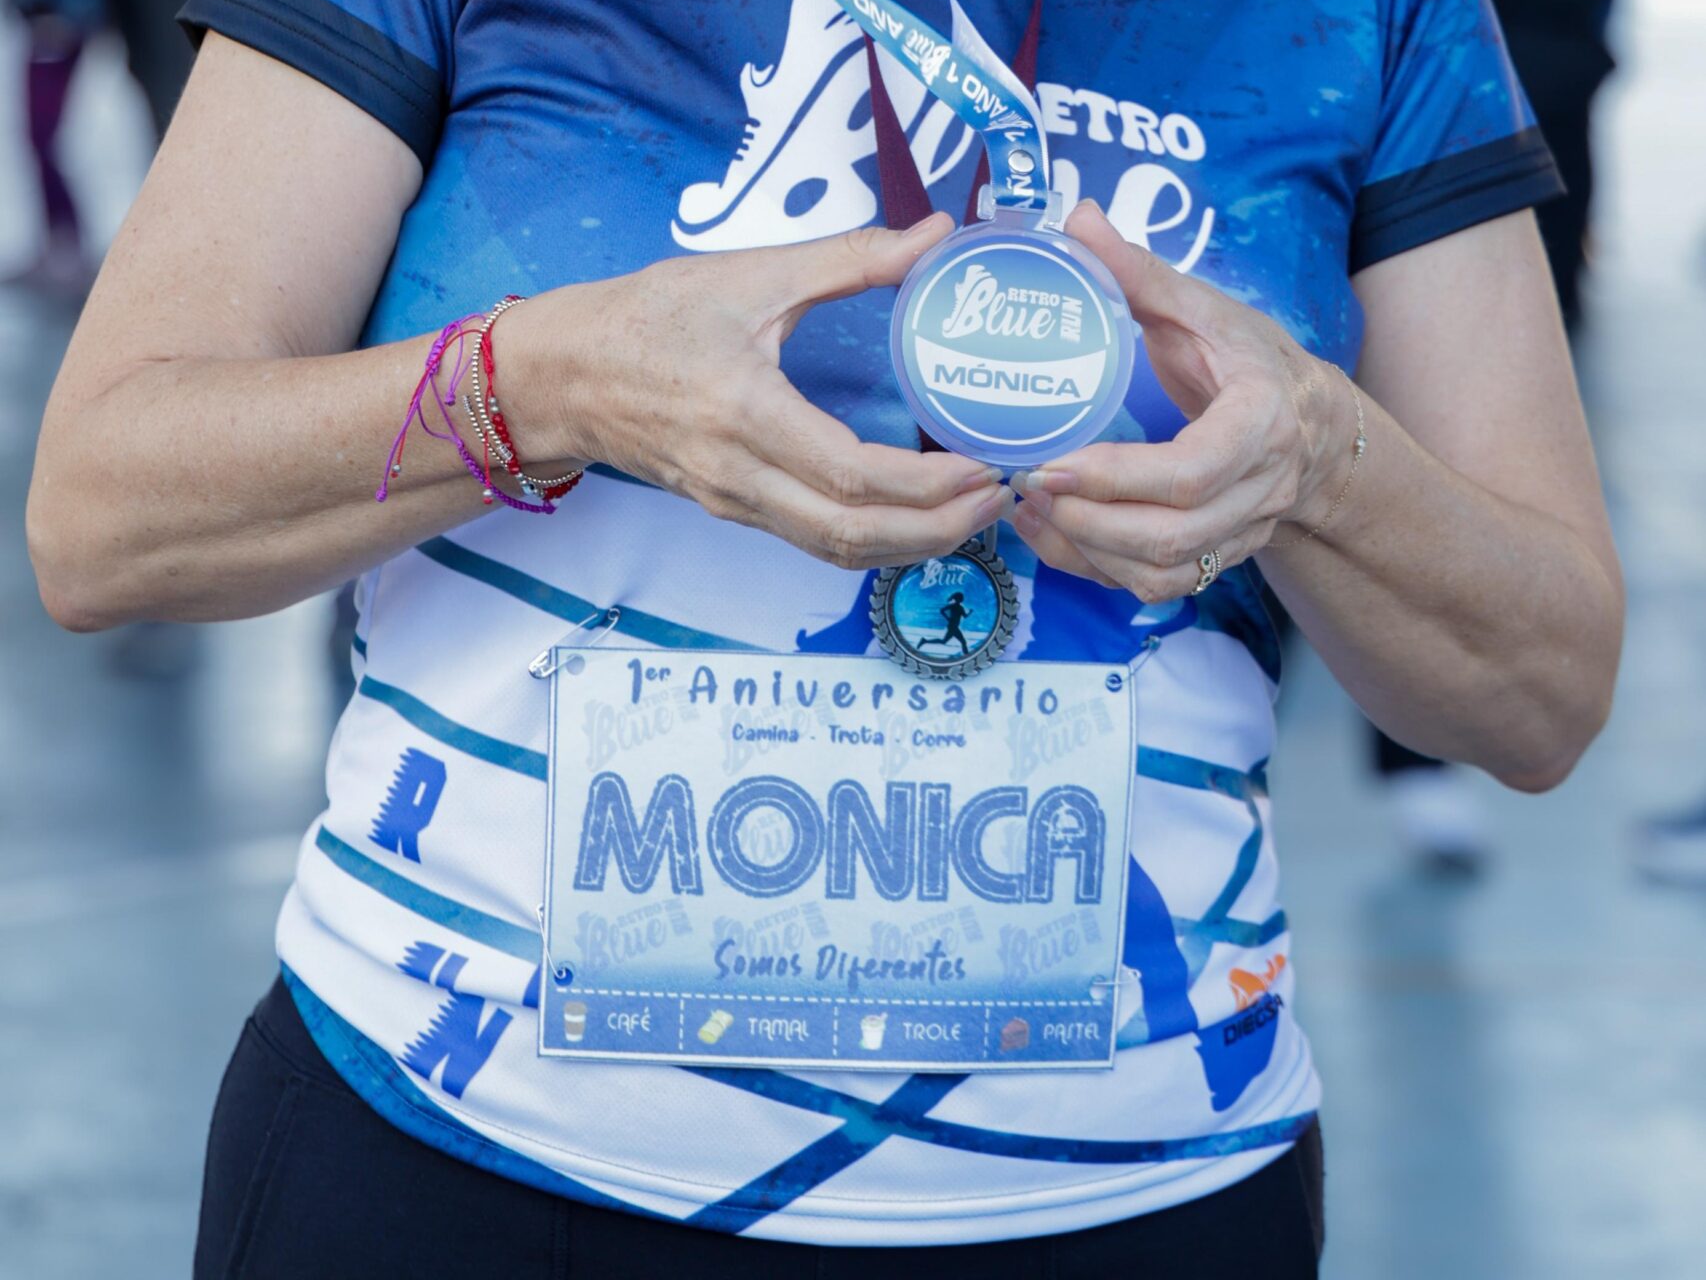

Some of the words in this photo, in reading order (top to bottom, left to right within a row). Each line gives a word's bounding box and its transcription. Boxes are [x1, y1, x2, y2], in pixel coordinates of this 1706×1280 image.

[945, 61, 959, 84] 1
[961, 73, 1009, 119] AÑO
[1035, 81, 1207, 162] ETRO
[942, 264, 1057, 339] Blue
[1007, 287, 1060, 308] RETRO
[934, 362, 1082, 399] MÓNICA
[627, 657, 672, 705] 1er
[687, 664, 1060, 716] Aniversario
[731, 722, 800, 744] Camina
[828, 724, 885, 746] Trota
[911, 728, 967, 749] Corre
[572, 770, 1107, 904] MONICA
[713, 938, 803, 981] Somos
[815, 939, 967, 992] Diferentes
[606, 1006, 651, 1036] CAFÉ
[747, 1016, 811, 1042] TAMAL
[903, 1021, 962, 1042] TROLE
[1042, 1021, 1101, 1045] PASTEL
